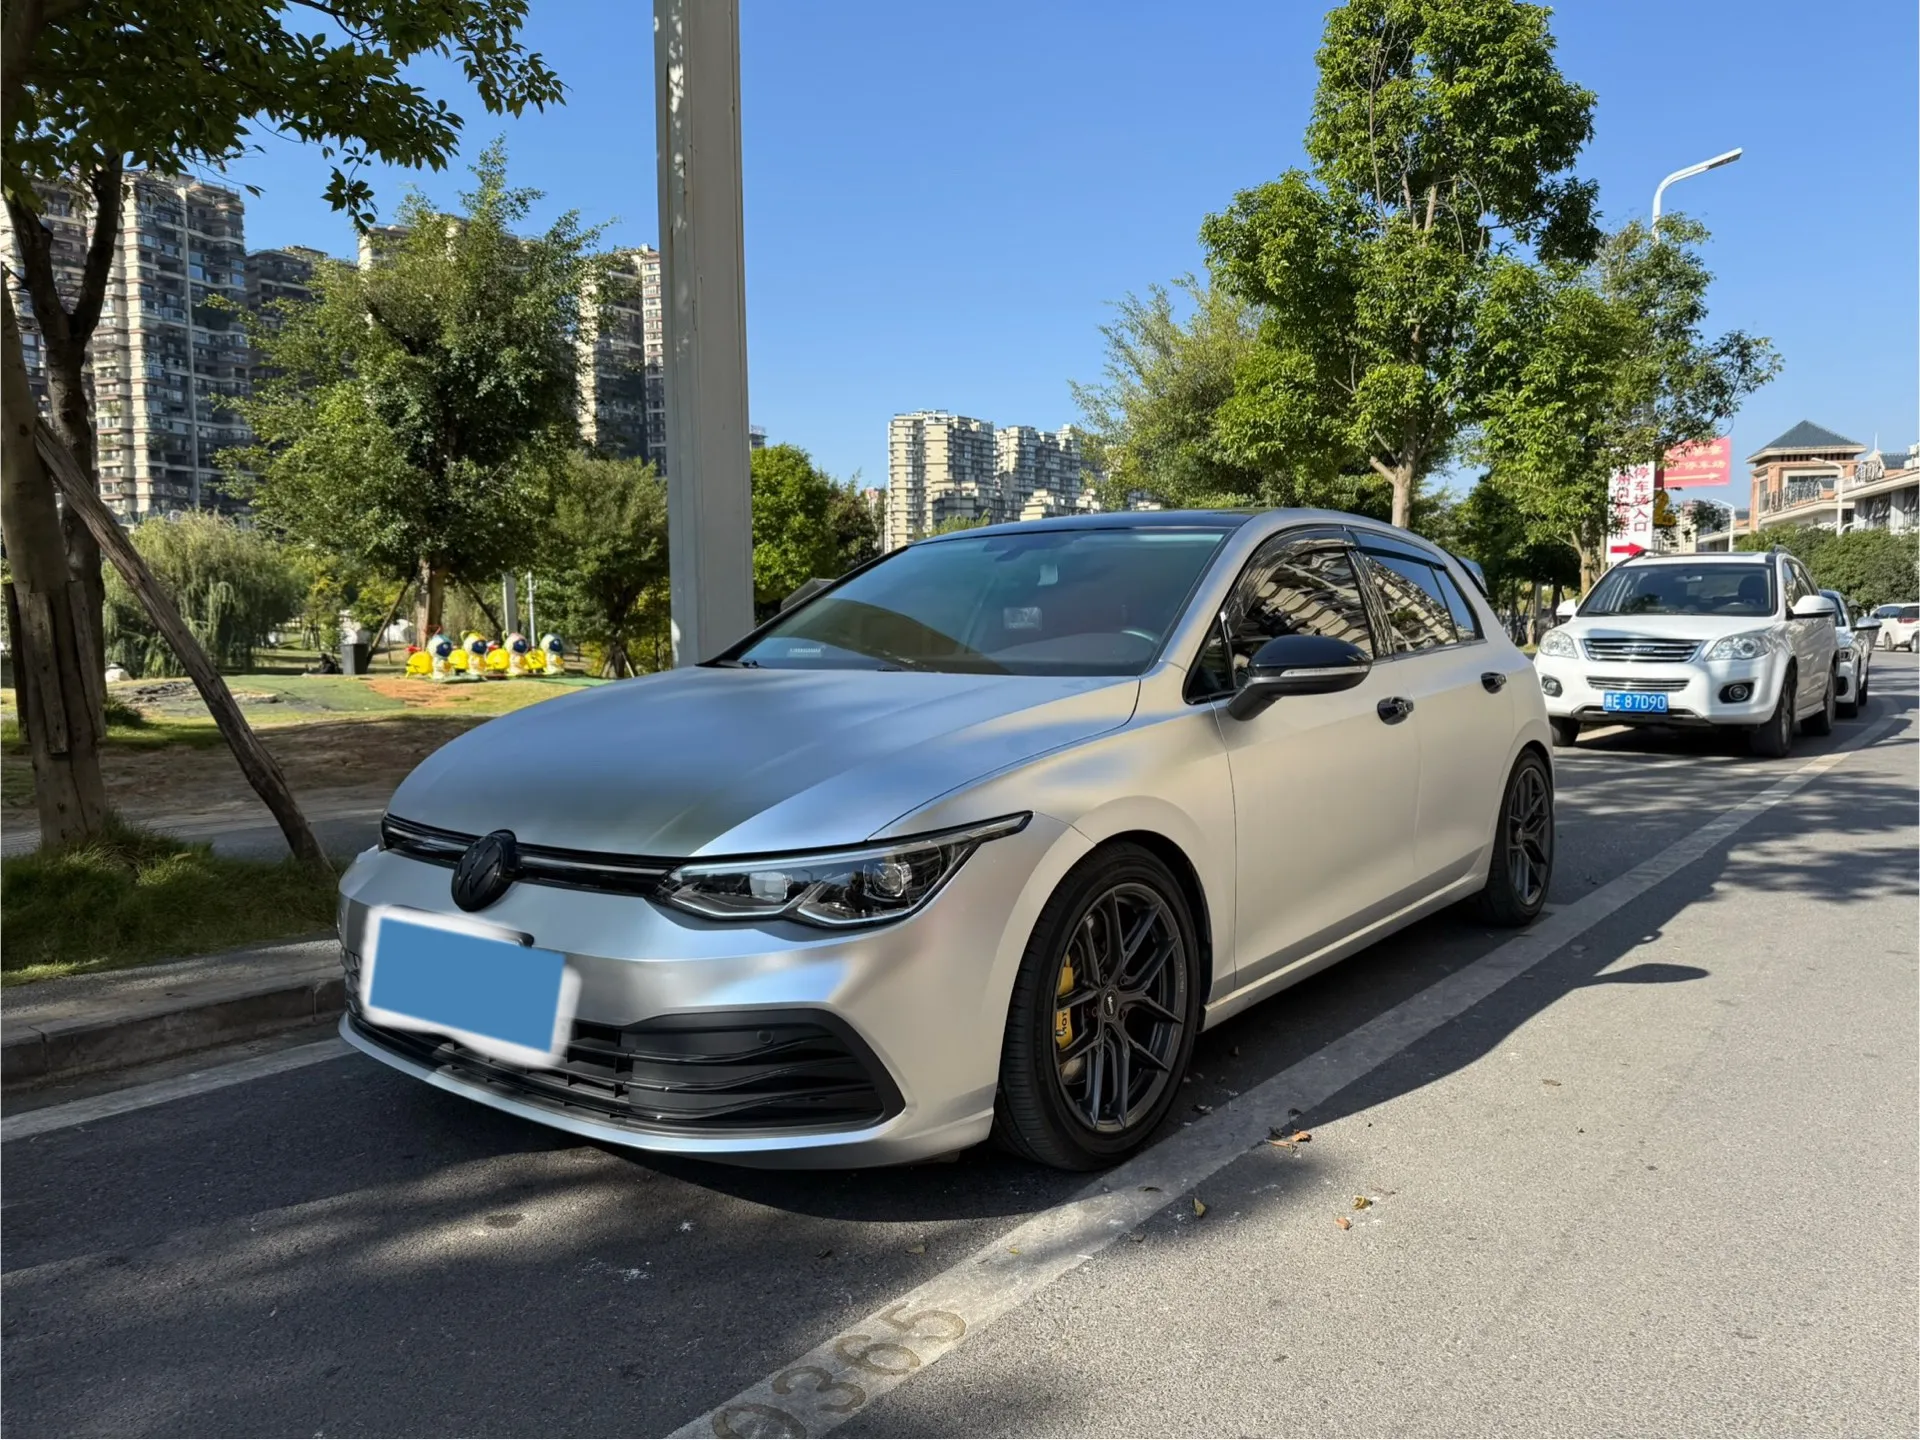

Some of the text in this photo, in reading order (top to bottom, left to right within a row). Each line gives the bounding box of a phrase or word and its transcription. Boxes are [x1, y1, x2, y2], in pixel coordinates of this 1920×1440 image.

[1632, 466, 1650, 532] 停车场入口
